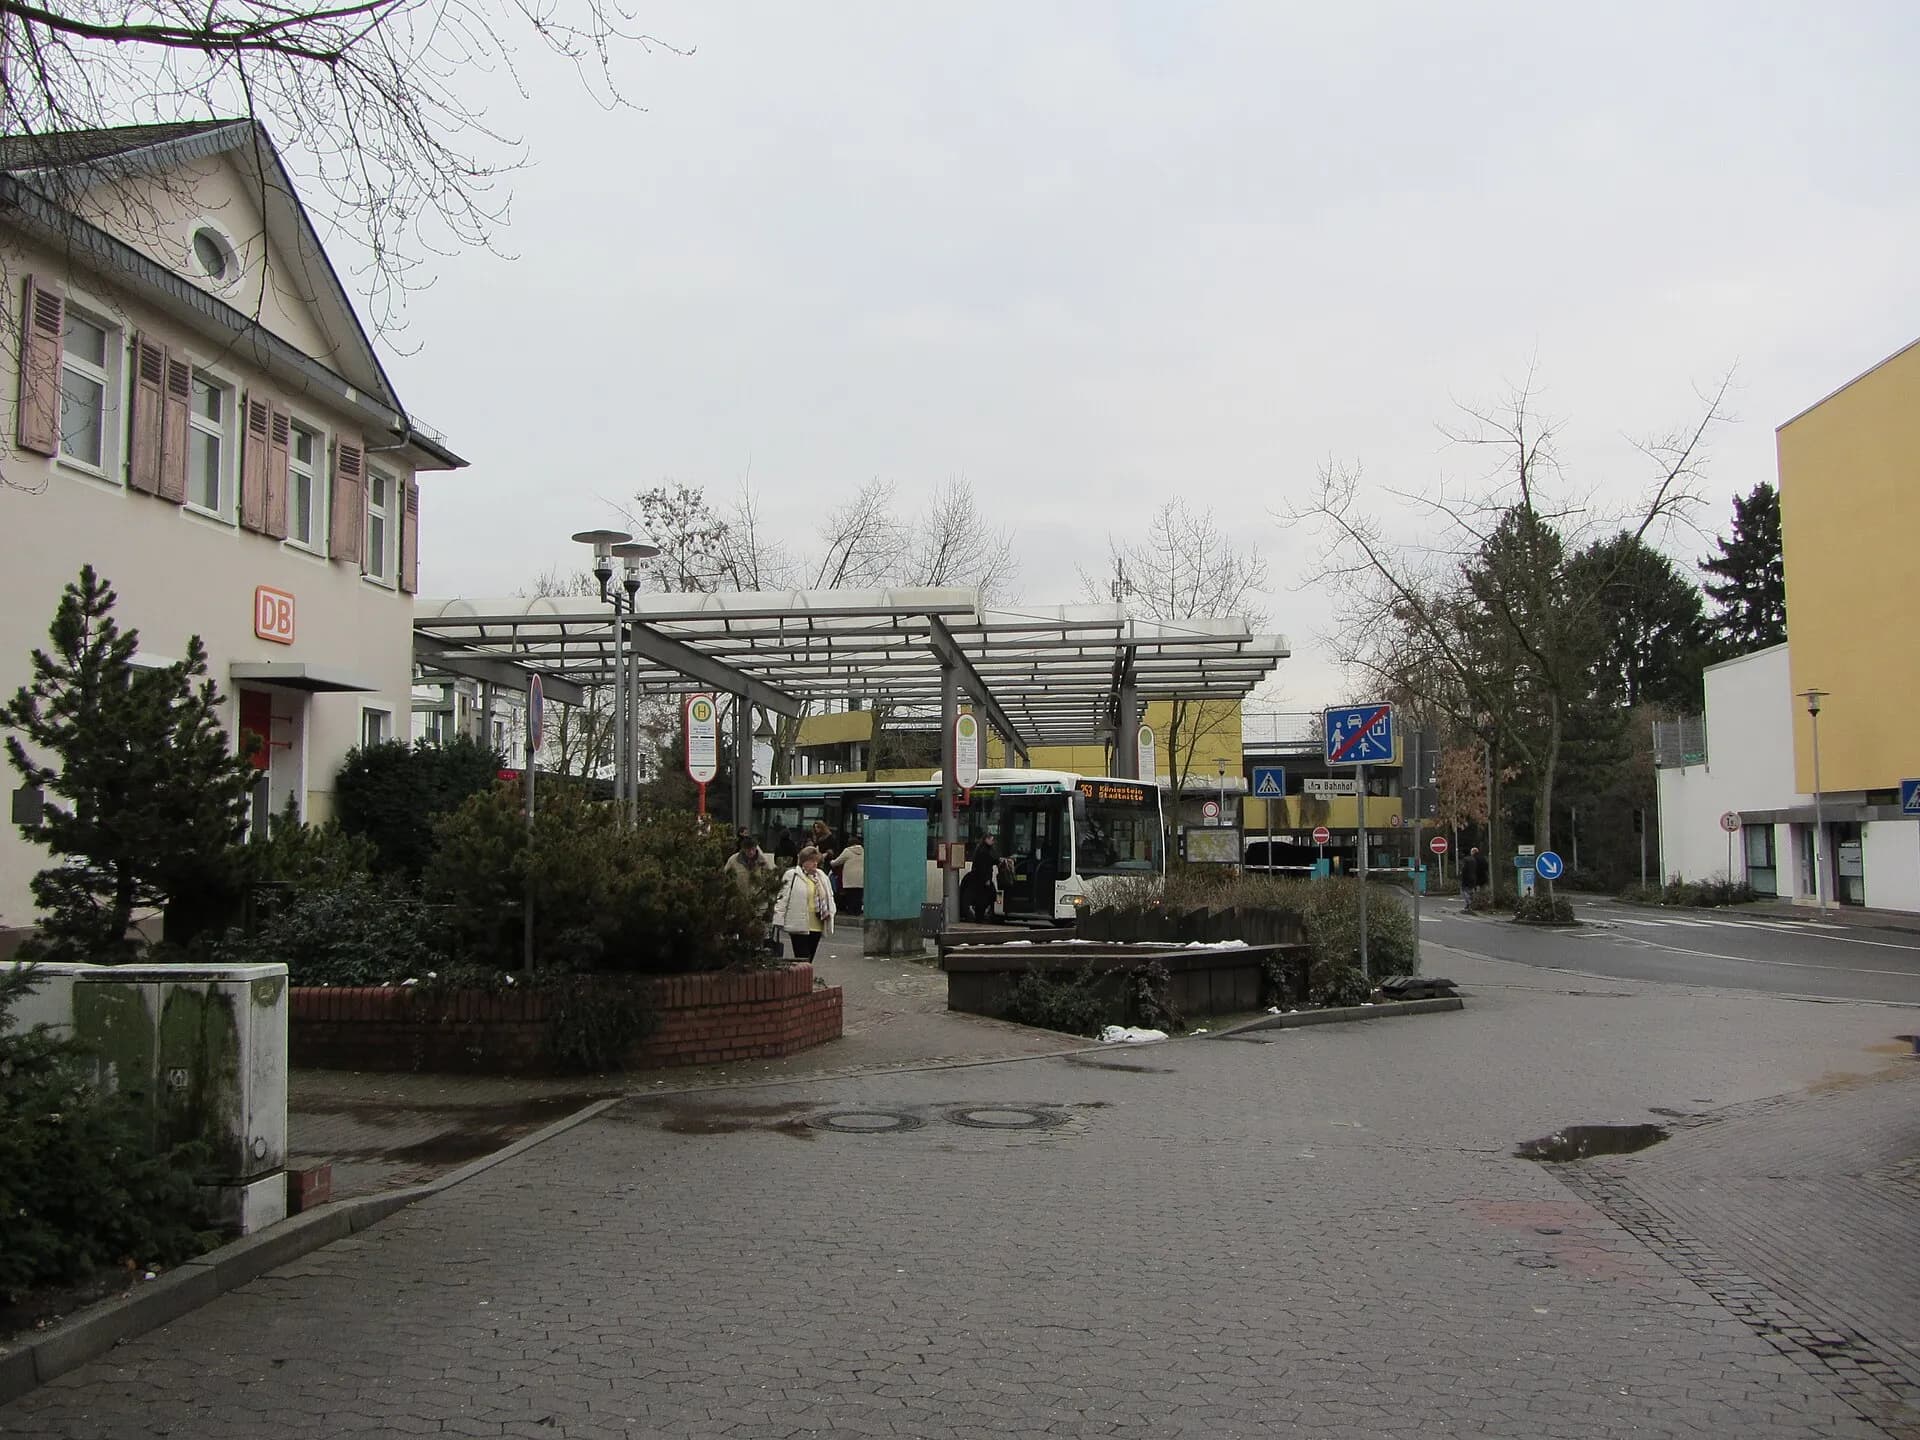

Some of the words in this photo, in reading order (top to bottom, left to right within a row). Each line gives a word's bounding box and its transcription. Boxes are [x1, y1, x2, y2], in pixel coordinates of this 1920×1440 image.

[263, 595, 290, 634] DB
[697, 705, 706, 718] H
[1324, 781, 1353, 790] Bahnhof
[1098, 791, 1144, 801] Stadtmitte
